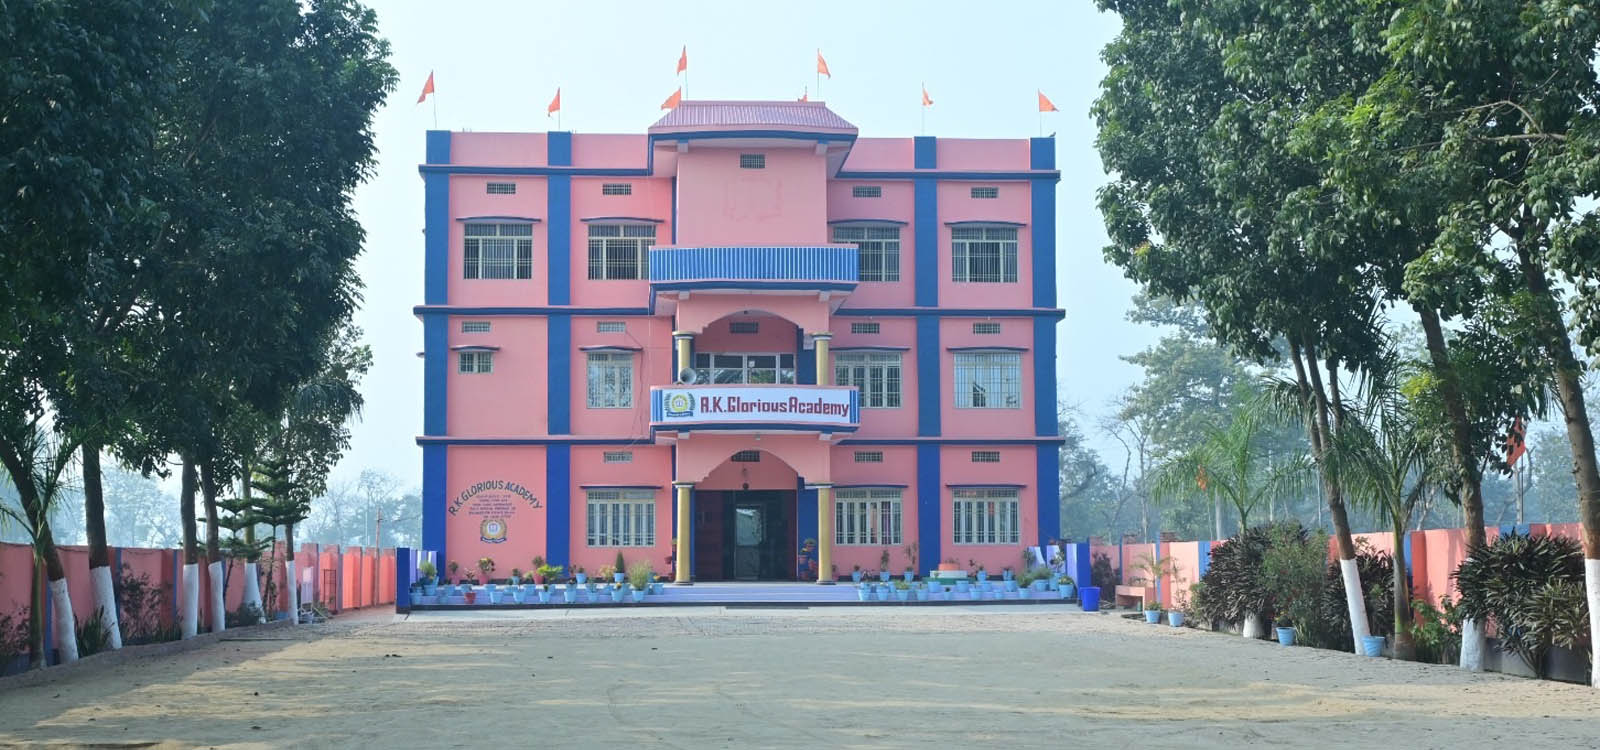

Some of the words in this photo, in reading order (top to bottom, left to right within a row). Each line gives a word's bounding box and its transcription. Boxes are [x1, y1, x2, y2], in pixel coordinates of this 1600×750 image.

[788, 396, 849, 417] Academy
[461, 480, 503, 501] GLORIOUS
[504, 481, 543, 509] ACADEMY
